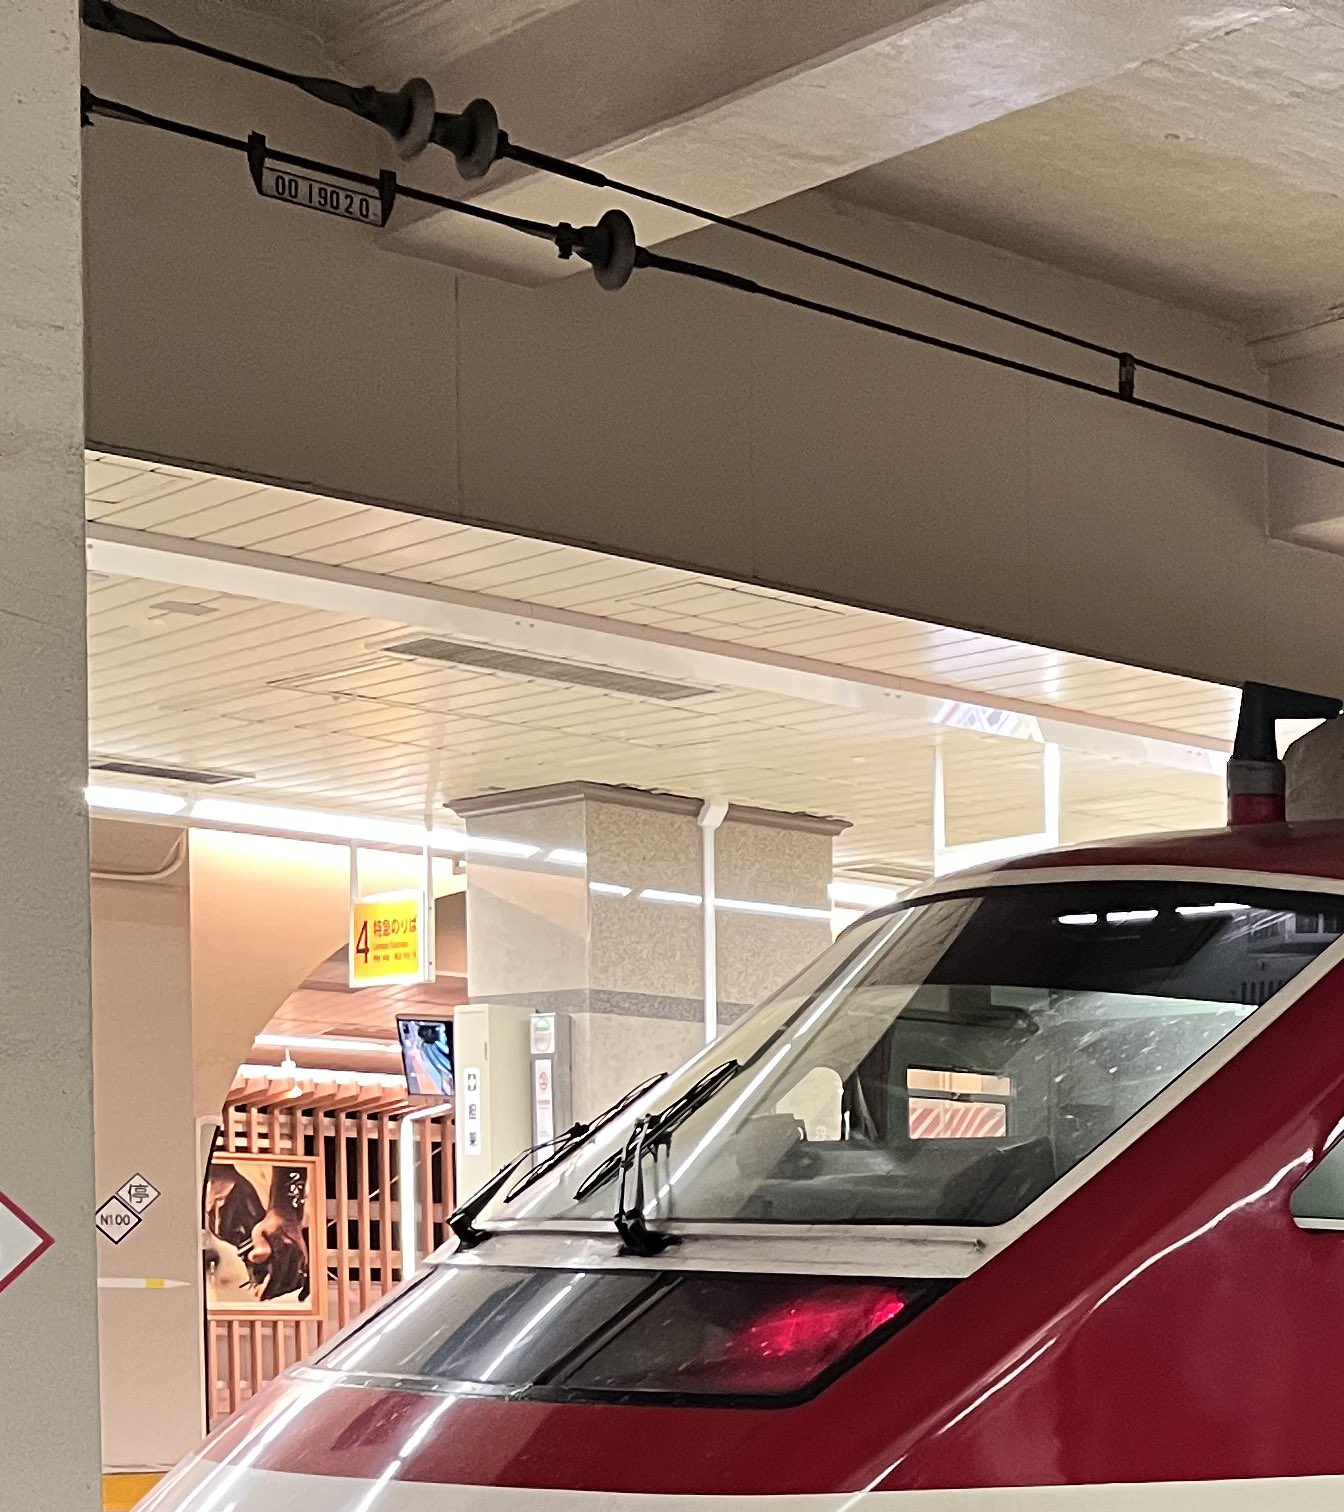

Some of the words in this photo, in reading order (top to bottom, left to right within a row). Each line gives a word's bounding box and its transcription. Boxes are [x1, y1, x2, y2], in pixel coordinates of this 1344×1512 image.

[355, 920, 370, 964] 4
[127, 1183, 150, 1204] 停
[100, 1214, 130, 1226] N100
